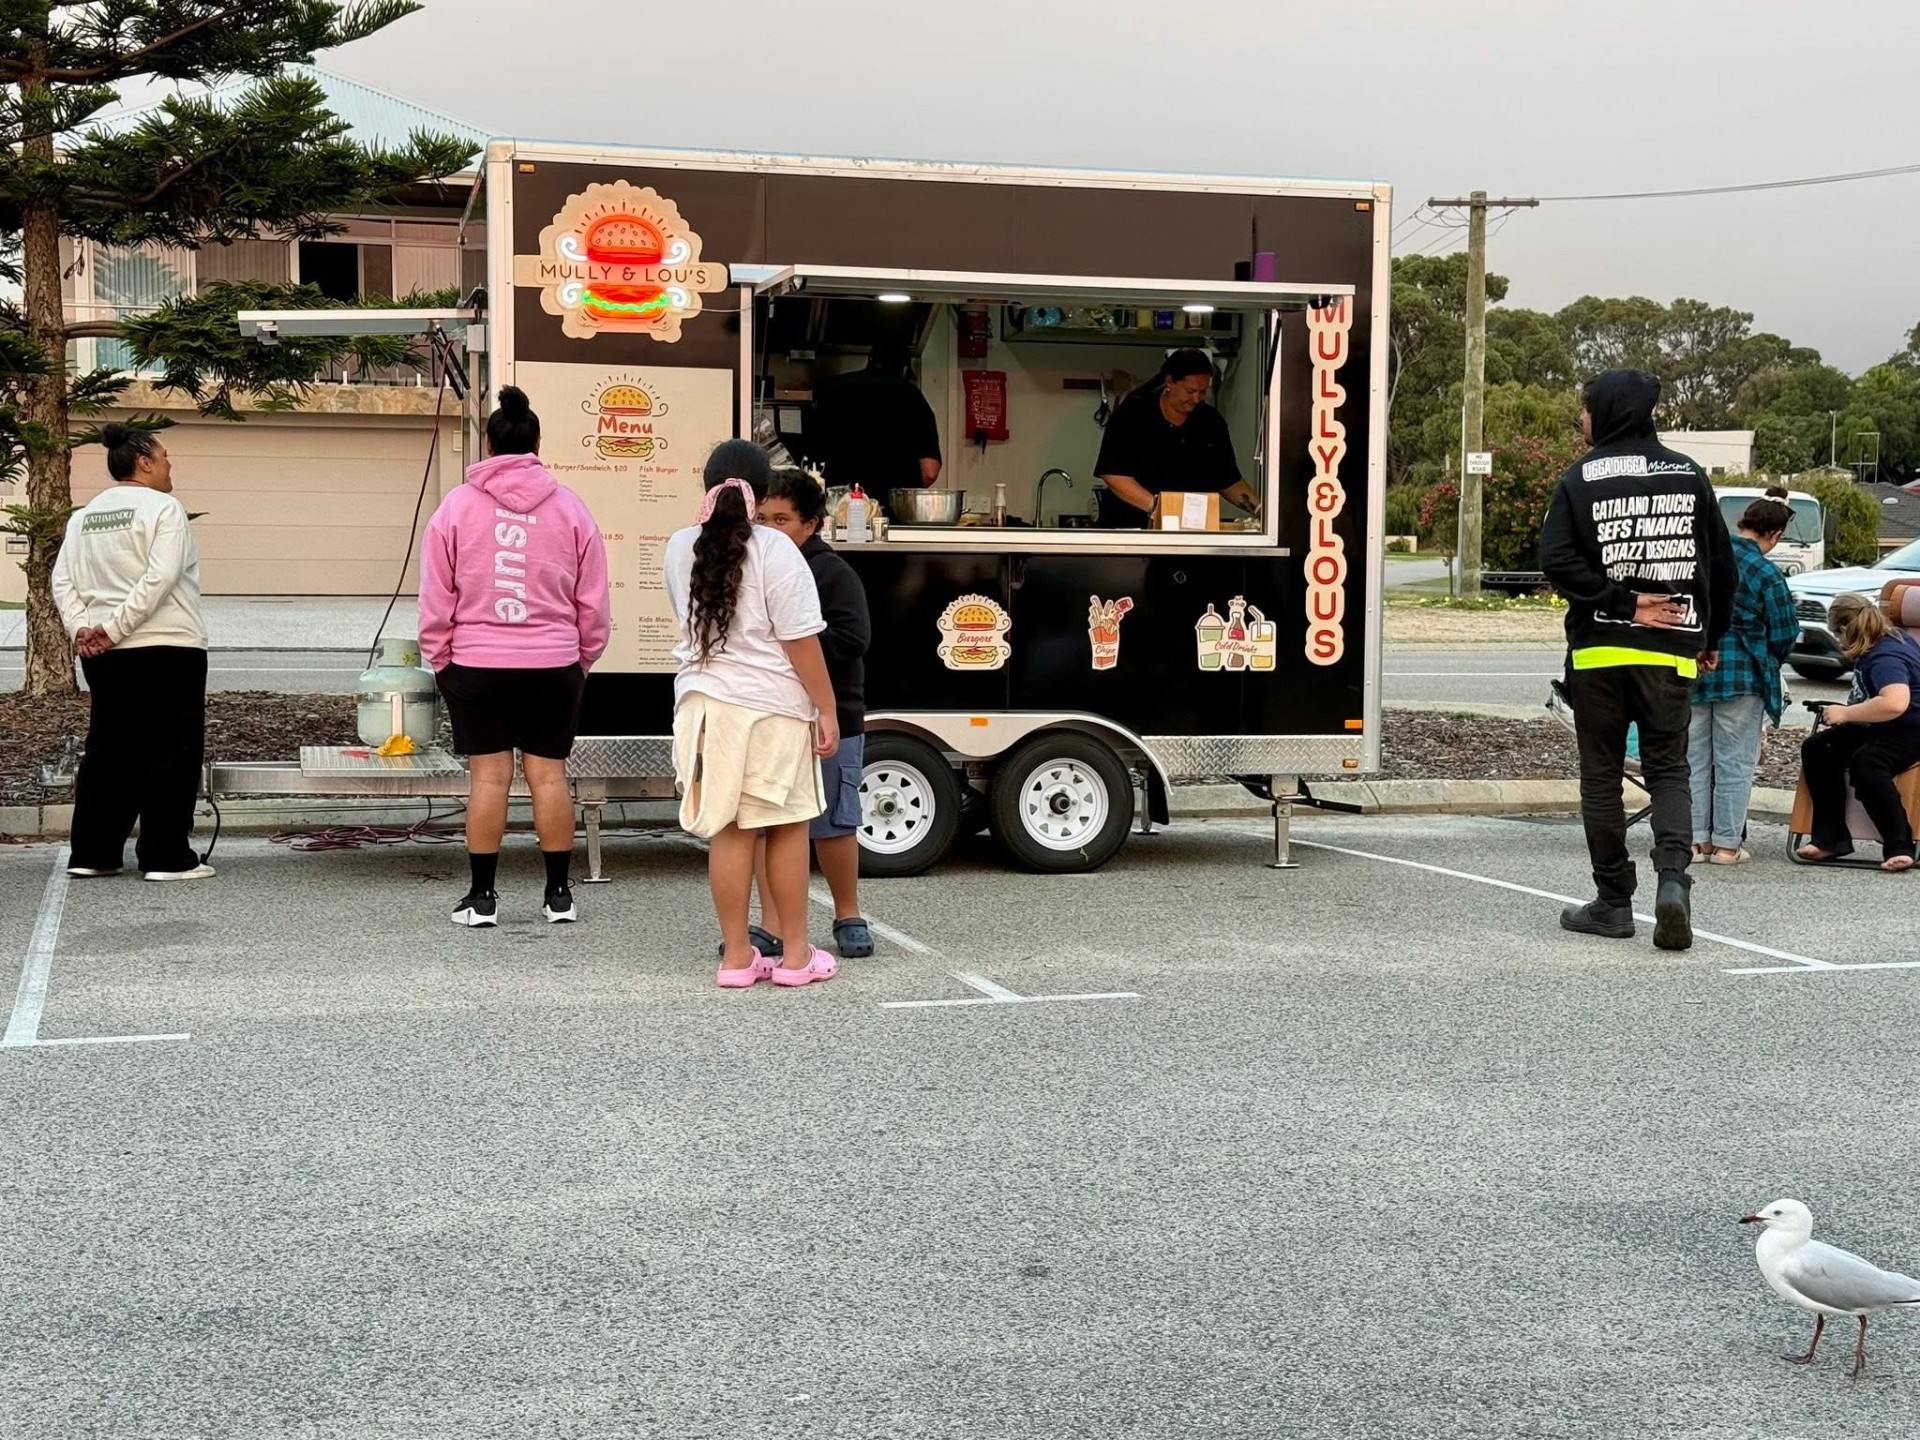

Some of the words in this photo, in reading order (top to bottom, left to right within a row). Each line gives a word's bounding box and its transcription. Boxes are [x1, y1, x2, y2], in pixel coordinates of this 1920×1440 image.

[540, 265, 612, 280] MULLY
[622, 267, 636, 281] &
[645, 267, 706, 284] LOU'S
[1314, 295, 1345, 474] MULLY
[597, 415, 653, 434] Menu
[655, 466, 679, 475] Burger
[1583, 459, 1612, 480] UGGA
[1613, 457, 1645, 475] DUGGA
[1647, 460, 1692, 472] Motorsport
[1315, 482, 1339, 512] &
[1592, 495, 1650, 521] CATALANO
[1651, 493, 1696, 515] TRUCKS
[1597, 518, 1632, 543] SEFS
[1645, 538, 1696, 561] DESIGNS
[1313, 519, 1339, 658] LOUS
[639, 615, 653, 623] Kids
[957, 632, 993, 647] Burgers
[1214, 641, 1234, 651] Cold
[1232, 641, 1258, 653] Drinks
